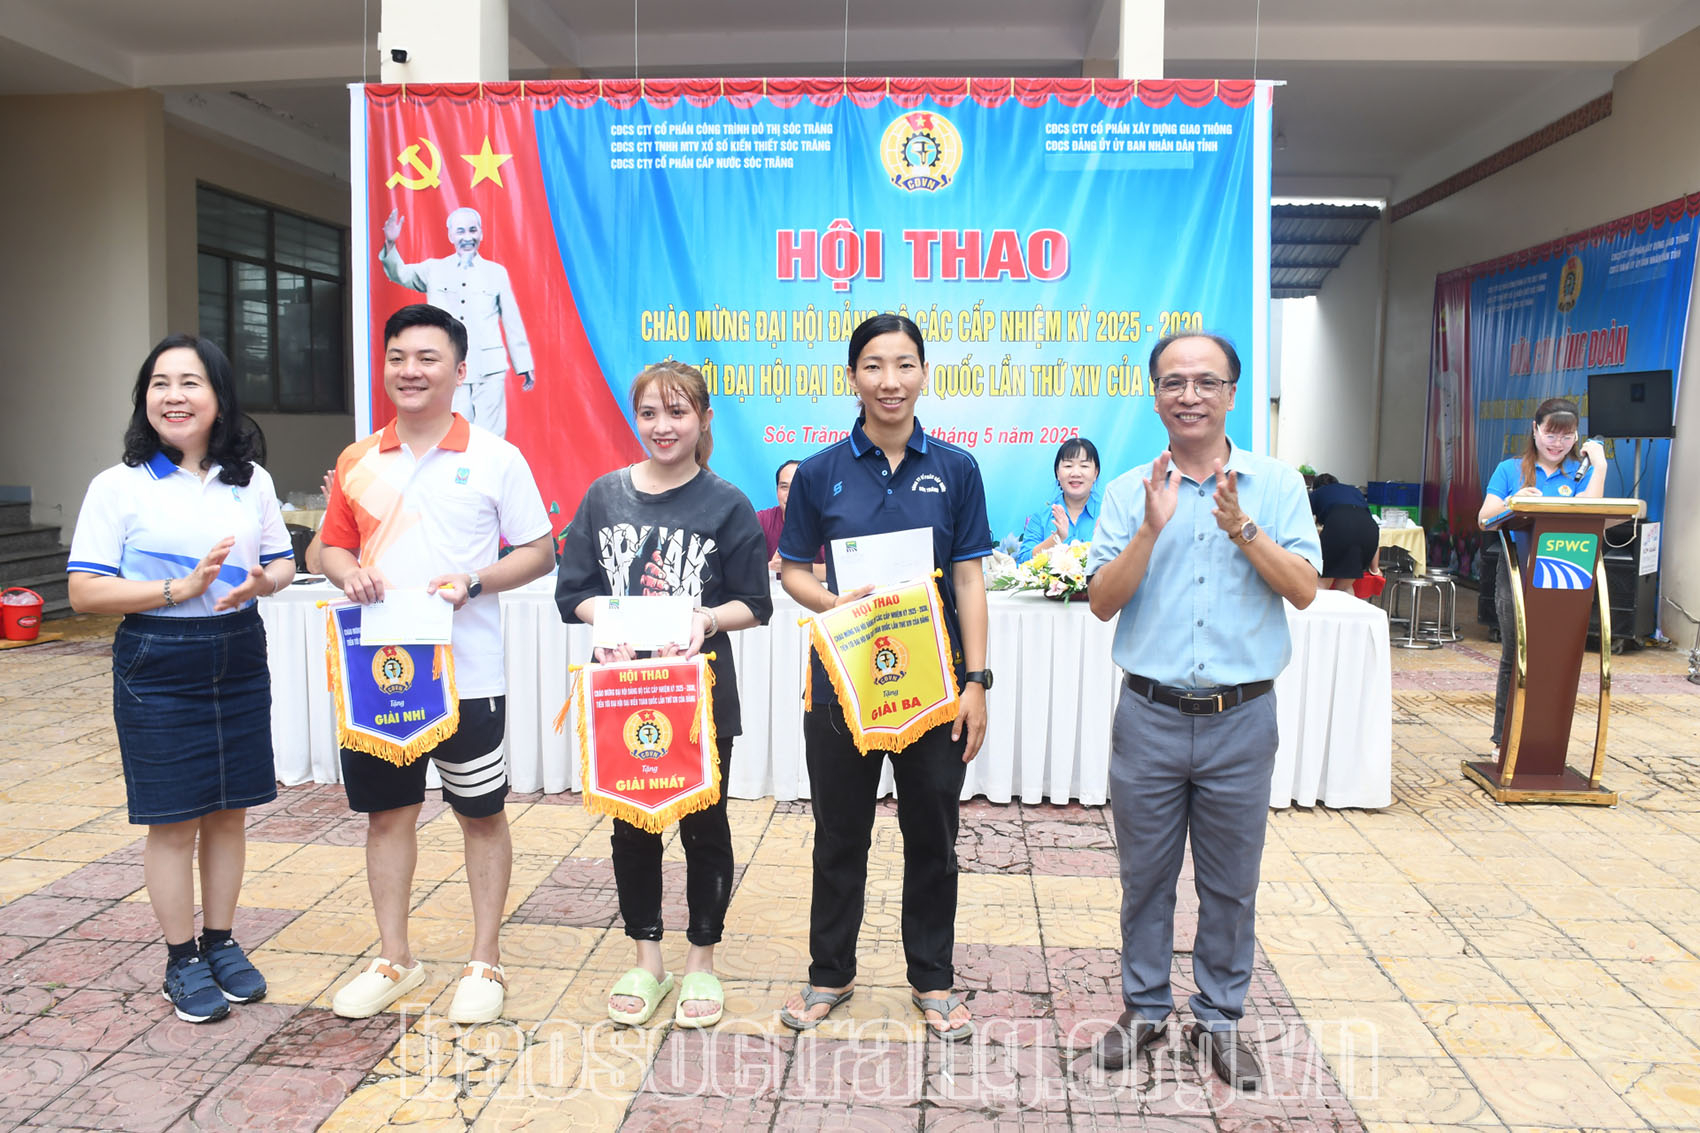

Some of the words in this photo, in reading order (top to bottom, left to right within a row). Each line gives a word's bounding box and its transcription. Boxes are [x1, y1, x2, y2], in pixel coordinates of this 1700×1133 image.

[637, 124, 652, 135] CTY
[696, 122, 720, 135] CÔNG
[723, 122, 749, 135] TRÌNH
[766, 123, 780, 136] THỊ
[783, 122, 800, 134] SÓC
[803, 122, 832, 134] TRĂNG
[1072, 123, 1088, 134] CTY
[1132, 122, 1150, 134] XÂY
[1152, 123, 1177, 136] DỰNG
[1180, 124, 1200, 134] GIAO
[1203, 122, 1232, 134] THÔNG
[637, 142, 652, 152] CTY
[654, 141, 678, 152] TNHH
[680, 141, 699, 152] MTV
[754, 138, 778, 152] THIẾT
[781, 139, 798, 152] SÓC
[801, 139, 830, 151] TRĂNG
[1127, 141, 1146, 151] BAN
[1148, 139, 1173, 151] NHÂN
[1176, 139, 1195, 151] DÂN
[637, 158, 653, 169] CTY
[744, 156, 761, 168] SÓC
[764, 156, 793, 168] TRĂNG
[776, 218, 883, 291] HỘI
[902, 229, 1069, 281] THAO
[641, 304, 690, 342] CHÀO
[696, 304, 750, 342] MỪNG
[755, 310, 786, 349] ĐẠI
[792, 304, 823, 349] HỘI
[915, 304, 952, 342] CÁC
[958, 299, 995, 341] CẤP
[1001, 304, 1061, 349] NHIỆM
[1067, 304, 1091, 342] KỲ
[1096, 311, 1141, 342] 2025
[723, 365, 754, 403] ĐẠI
[760, 358, 791, 403] HỘI
[796, 365, 826, 403] ĐẠI
[934, 354, 984, 400] QUỐC
[989, 354, 1026, 396] LẦN
[1031, 358, 1068, 396] THỨ
[1071, 365, 1102, 396] XIV
[1107, 354, 1144, 396] CỦA
[764, 425, 796, 443] Sóc
[984, 427, 992, 444] 5
[998, 426, 1034, 443] năm
[1546, 540, 1590, 552] SPWC
[852, 602, 872, 618] HỘI
[873, 594, 900, 608] THAO
[619, 670, 638, 684] HỘI
[641, 669, 669, 680] THAO
[871, 699, 897, 720] GIẢI
[902, 697, 921, 711] BA
[375, 710, 400, 725] GIẢI
[616, 777, 644, 791] GIẢI
[649, 774, 685, 790] NHẤT
